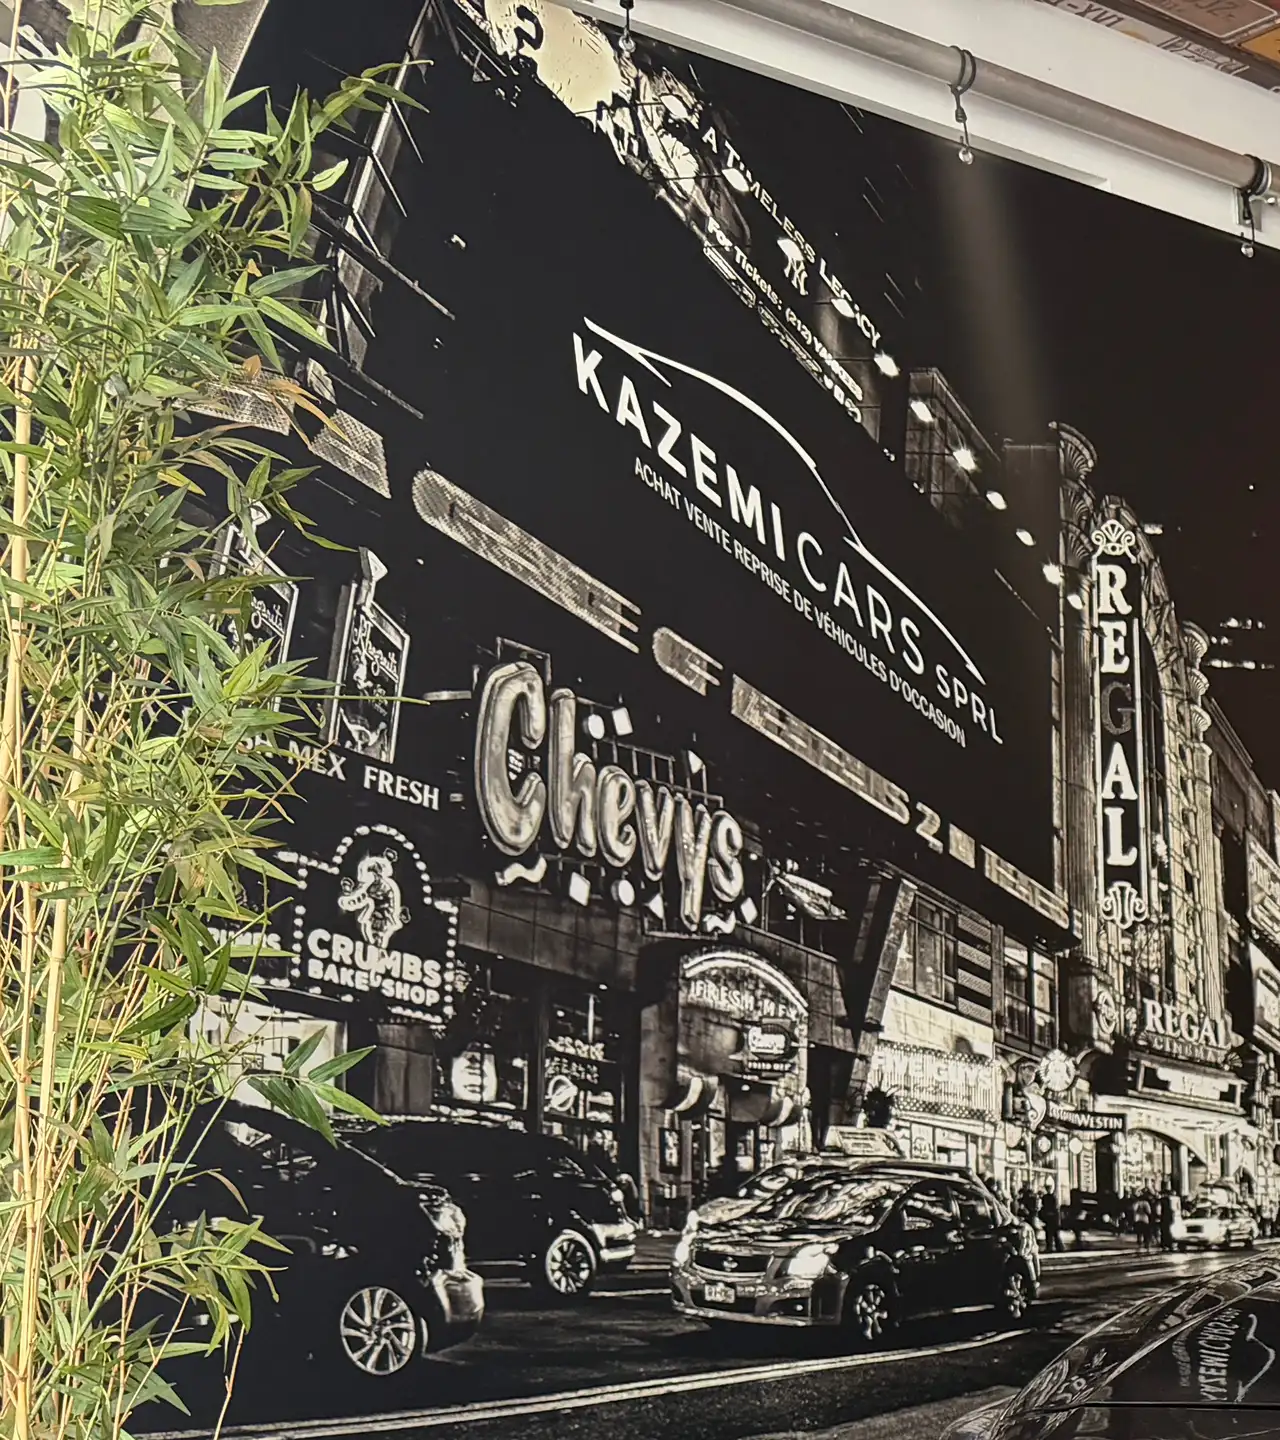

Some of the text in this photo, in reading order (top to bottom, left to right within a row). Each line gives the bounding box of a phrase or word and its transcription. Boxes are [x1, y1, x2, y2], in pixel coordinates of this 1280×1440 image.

[702, 126, 719, 154] A
[572, 332, 786, 562] KAZEMI
[796, 531, 926, 675] CARS
[934, 663, 1004, 746] SPRL
[634, 456, 967, 750] ACHAT VENTE REPRISE DE VÉHICULES D'OCCASION
[363, 764, 441, 812] FRESH
[472, 660, 745, 932] Chevys
[306, 928, 442, 989] CRUMBS
[307, 958, 441, 1007] BAKE SHOP
[1142, 997, 1233, 1048] REGAL
